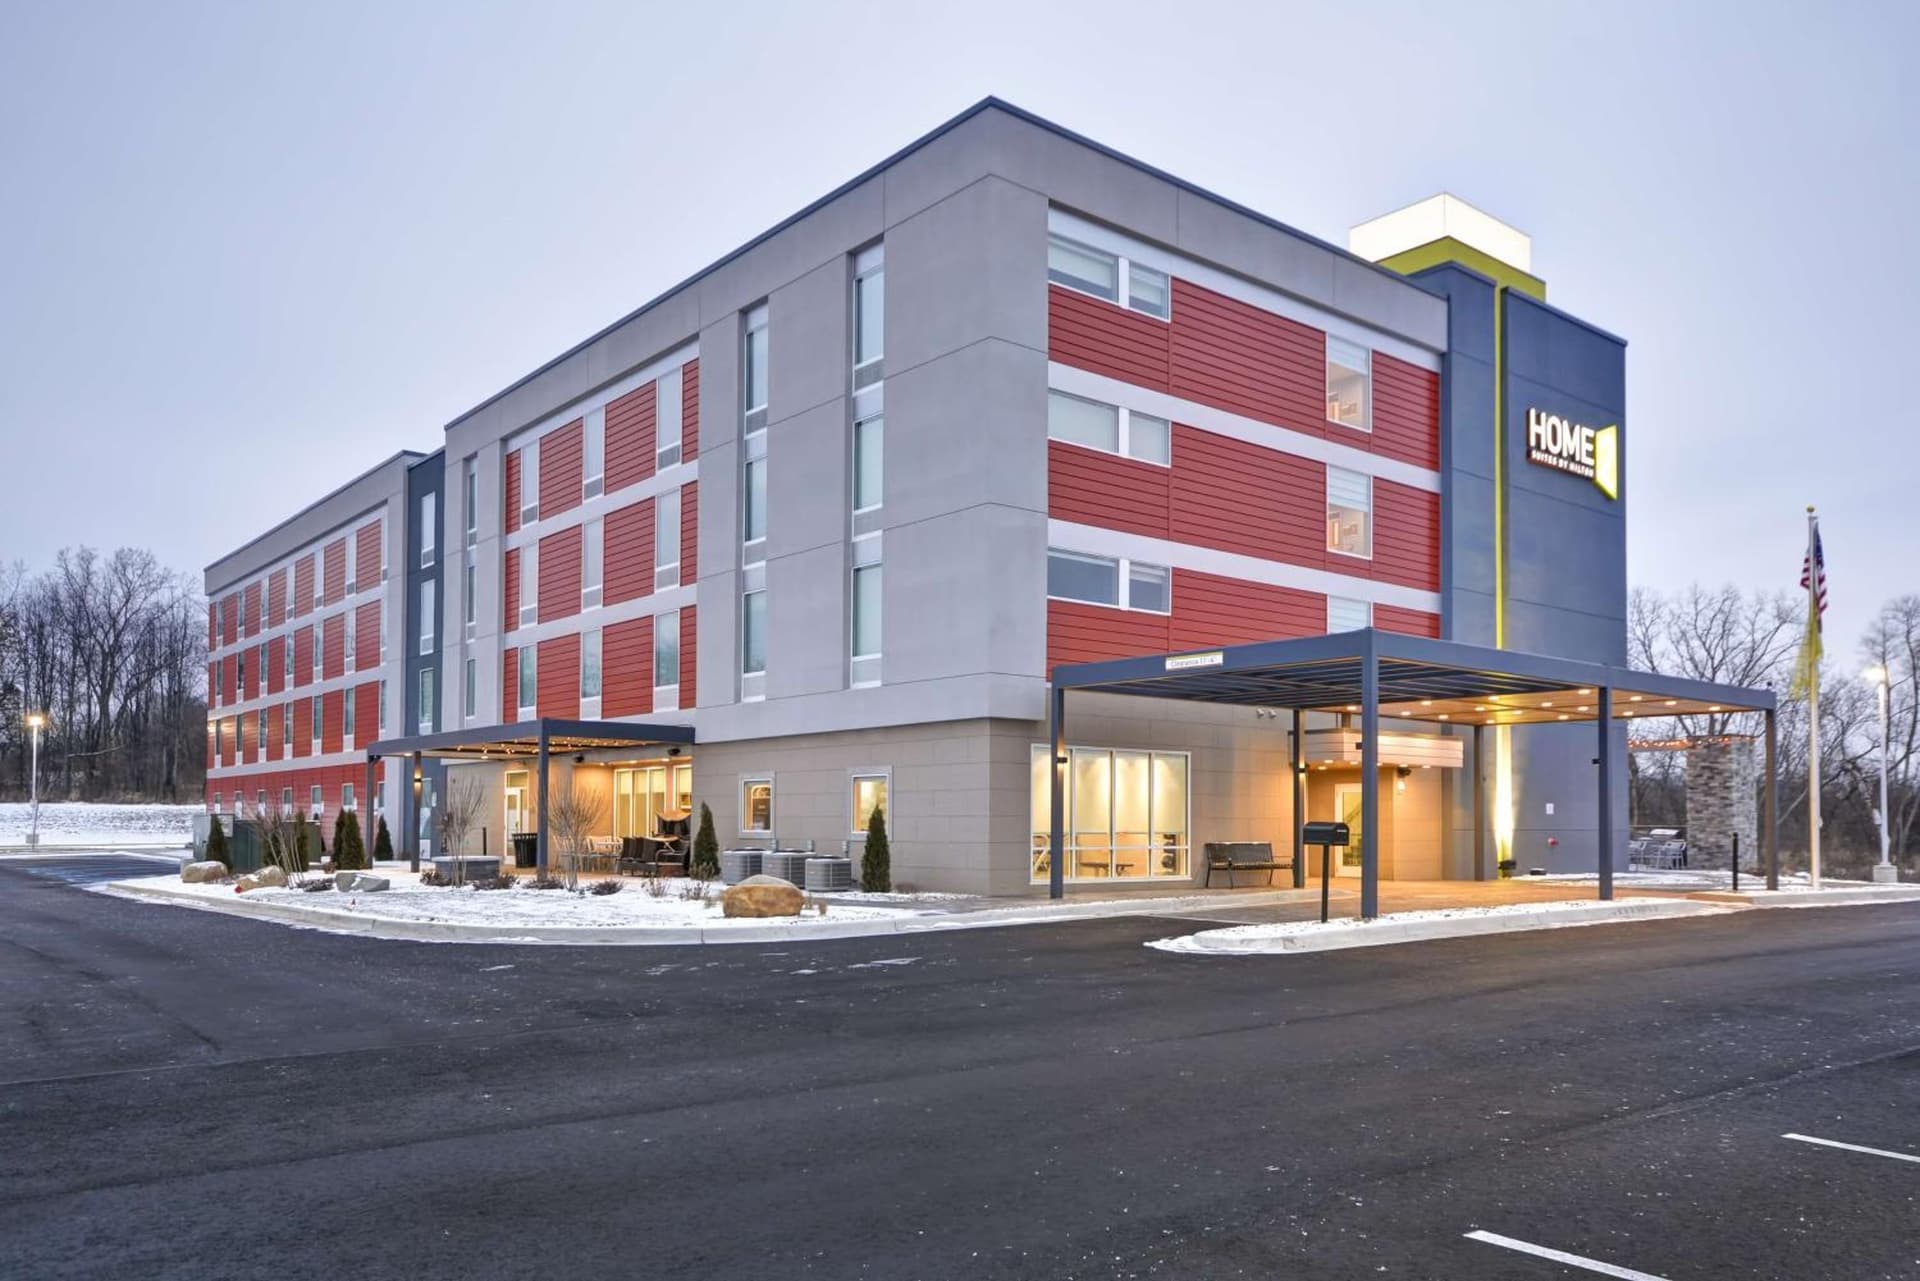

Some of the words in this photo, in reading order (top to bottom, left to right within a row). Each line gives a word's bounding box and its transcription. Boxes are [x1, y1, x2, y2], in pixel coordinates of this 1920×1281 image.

[1529, 407, 1595, 466] HOME
[1531, 449, 1557, 466] SUITES
[1558, 458, 1569, 469] BY
